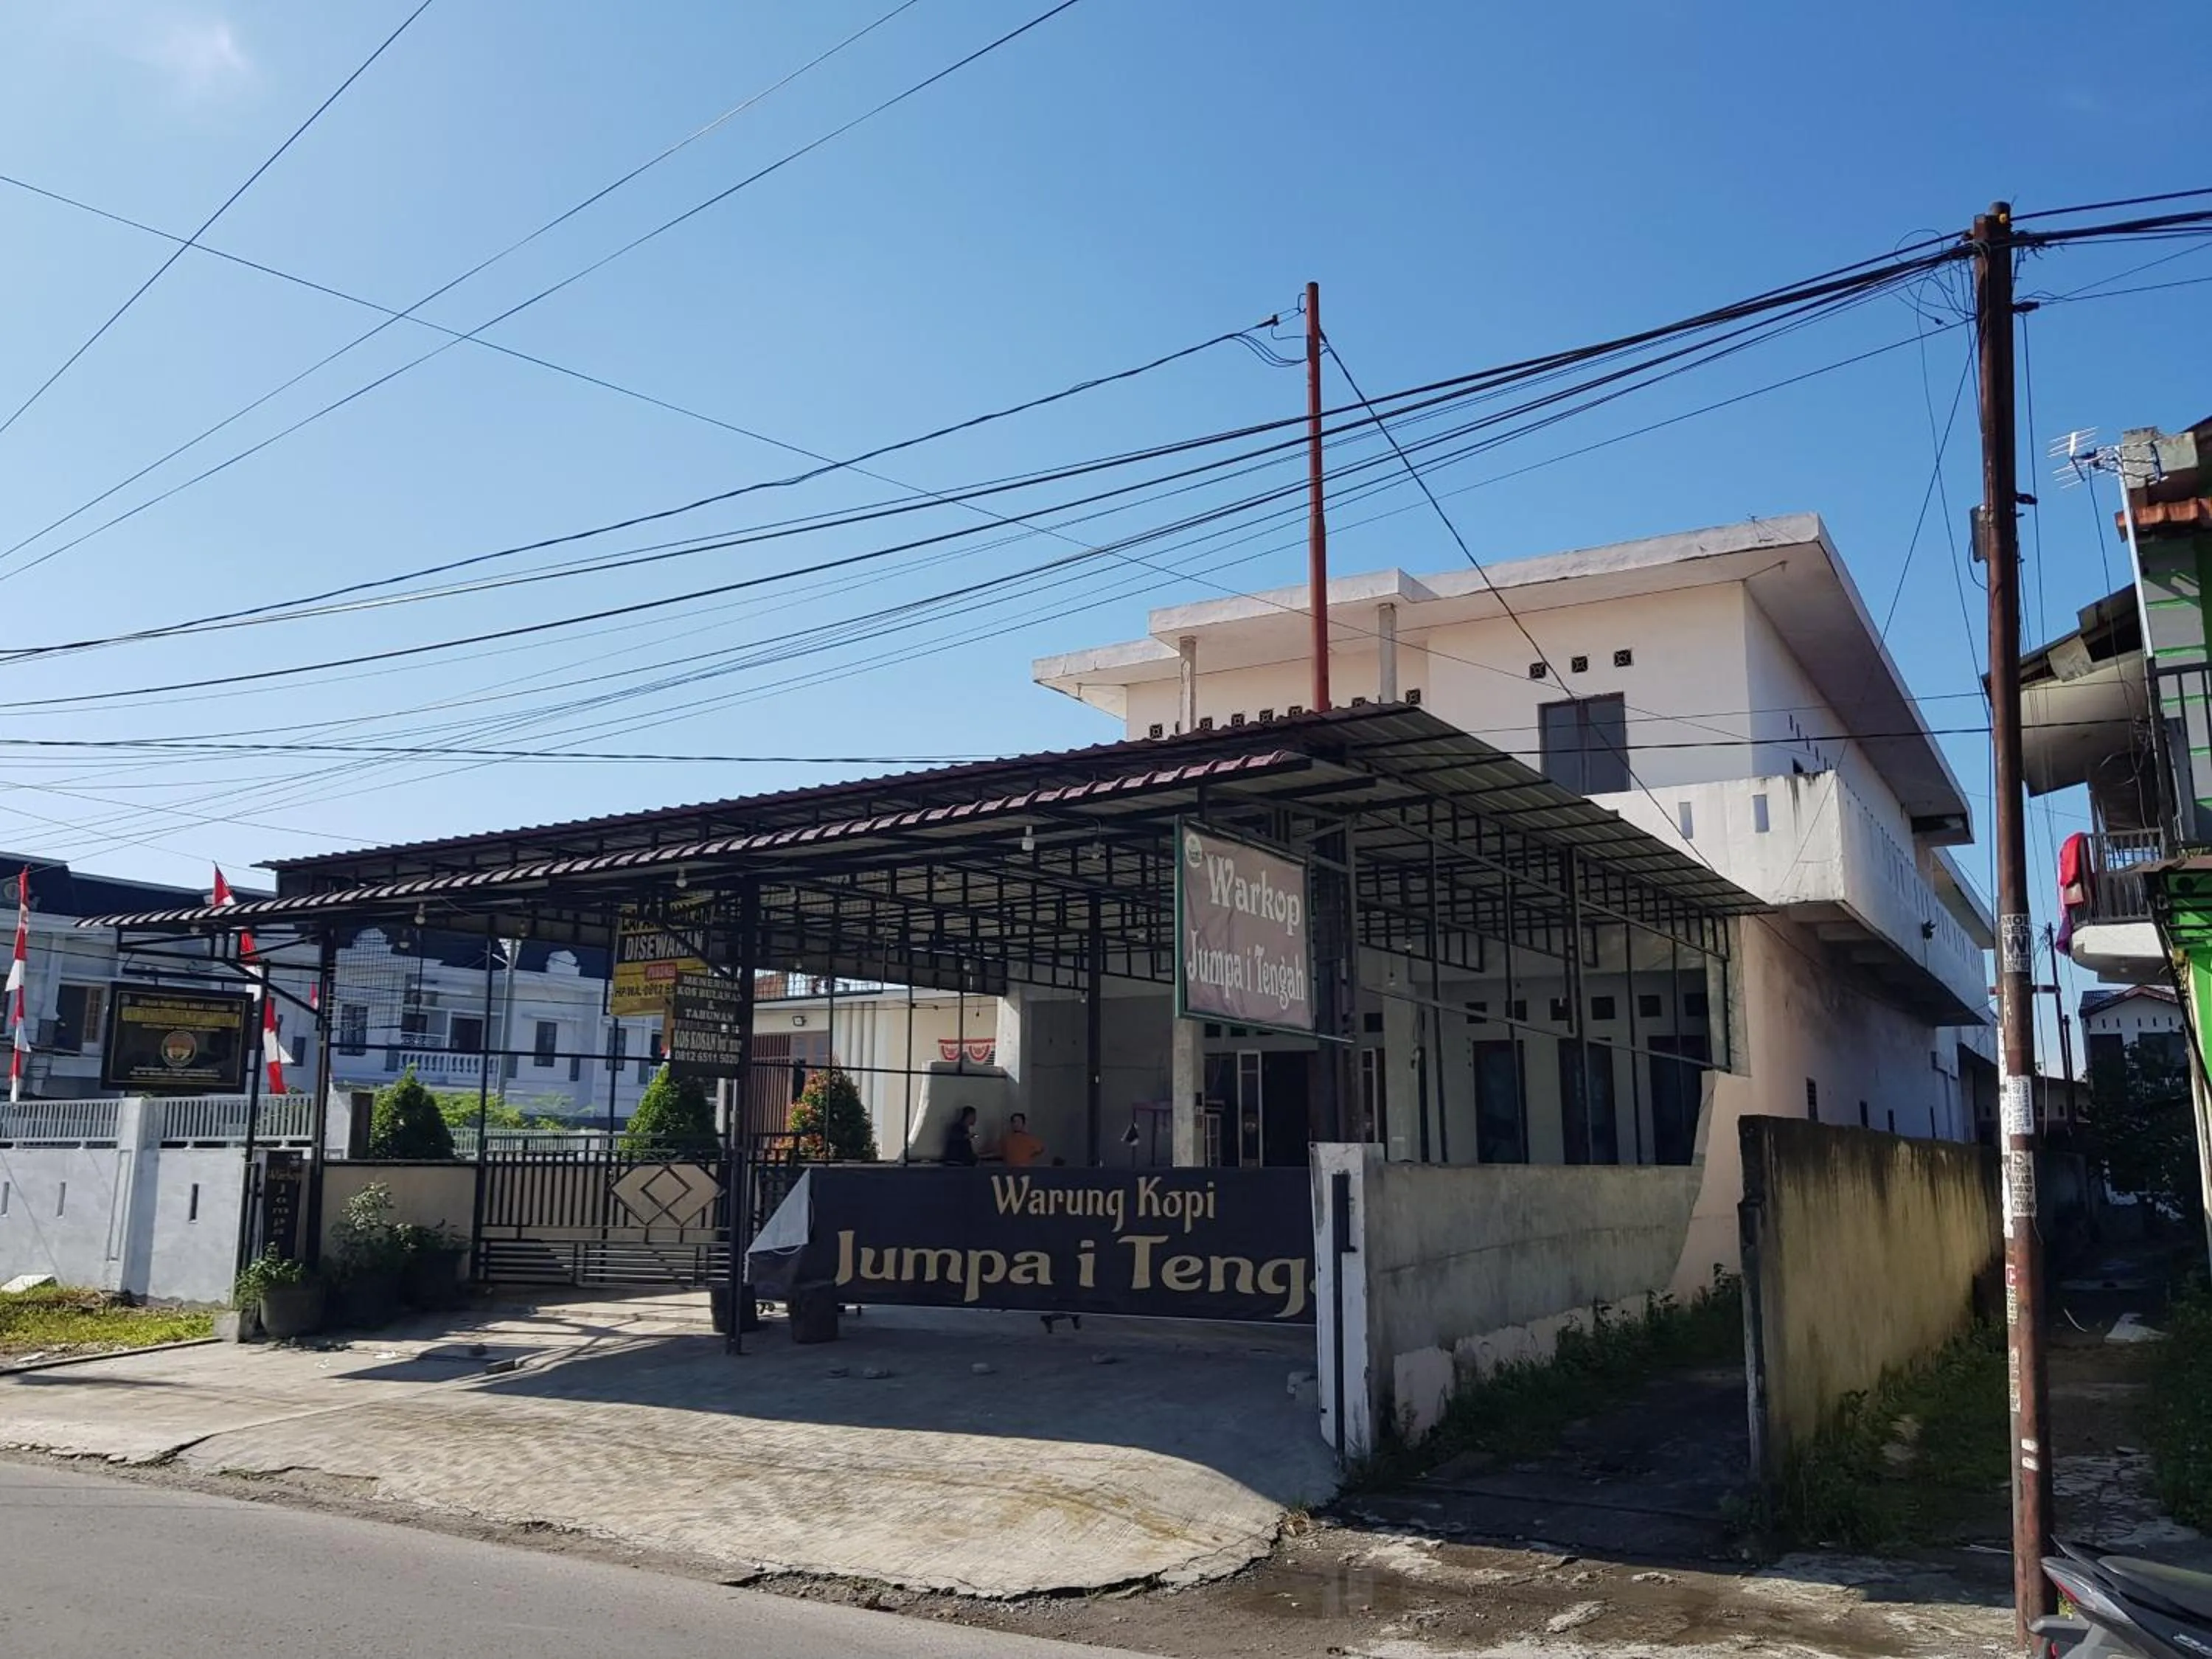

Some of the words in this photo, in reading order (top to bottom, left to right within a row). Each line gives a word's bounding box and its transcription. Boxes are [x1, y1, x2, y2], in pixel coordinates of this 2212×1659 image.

[1205, 854, 1300, 936] Warkop
[1187, 929, 1242, 998] Jumpa
[1246, 947, 1252, 992] i
[1255, 943, 1305, 1010] Tengah
[684, 1008, 734, 1023] TAHUNAN
[991, 1175, 1124, 1233] Warung
[1137, 1176, 1215, 1234] Kopi
[835, 1230, 1054, 1303] Jumpa
[1077, 1239, 1096, 1287] i
[1117, 1235, 1317, 1318] Teng
